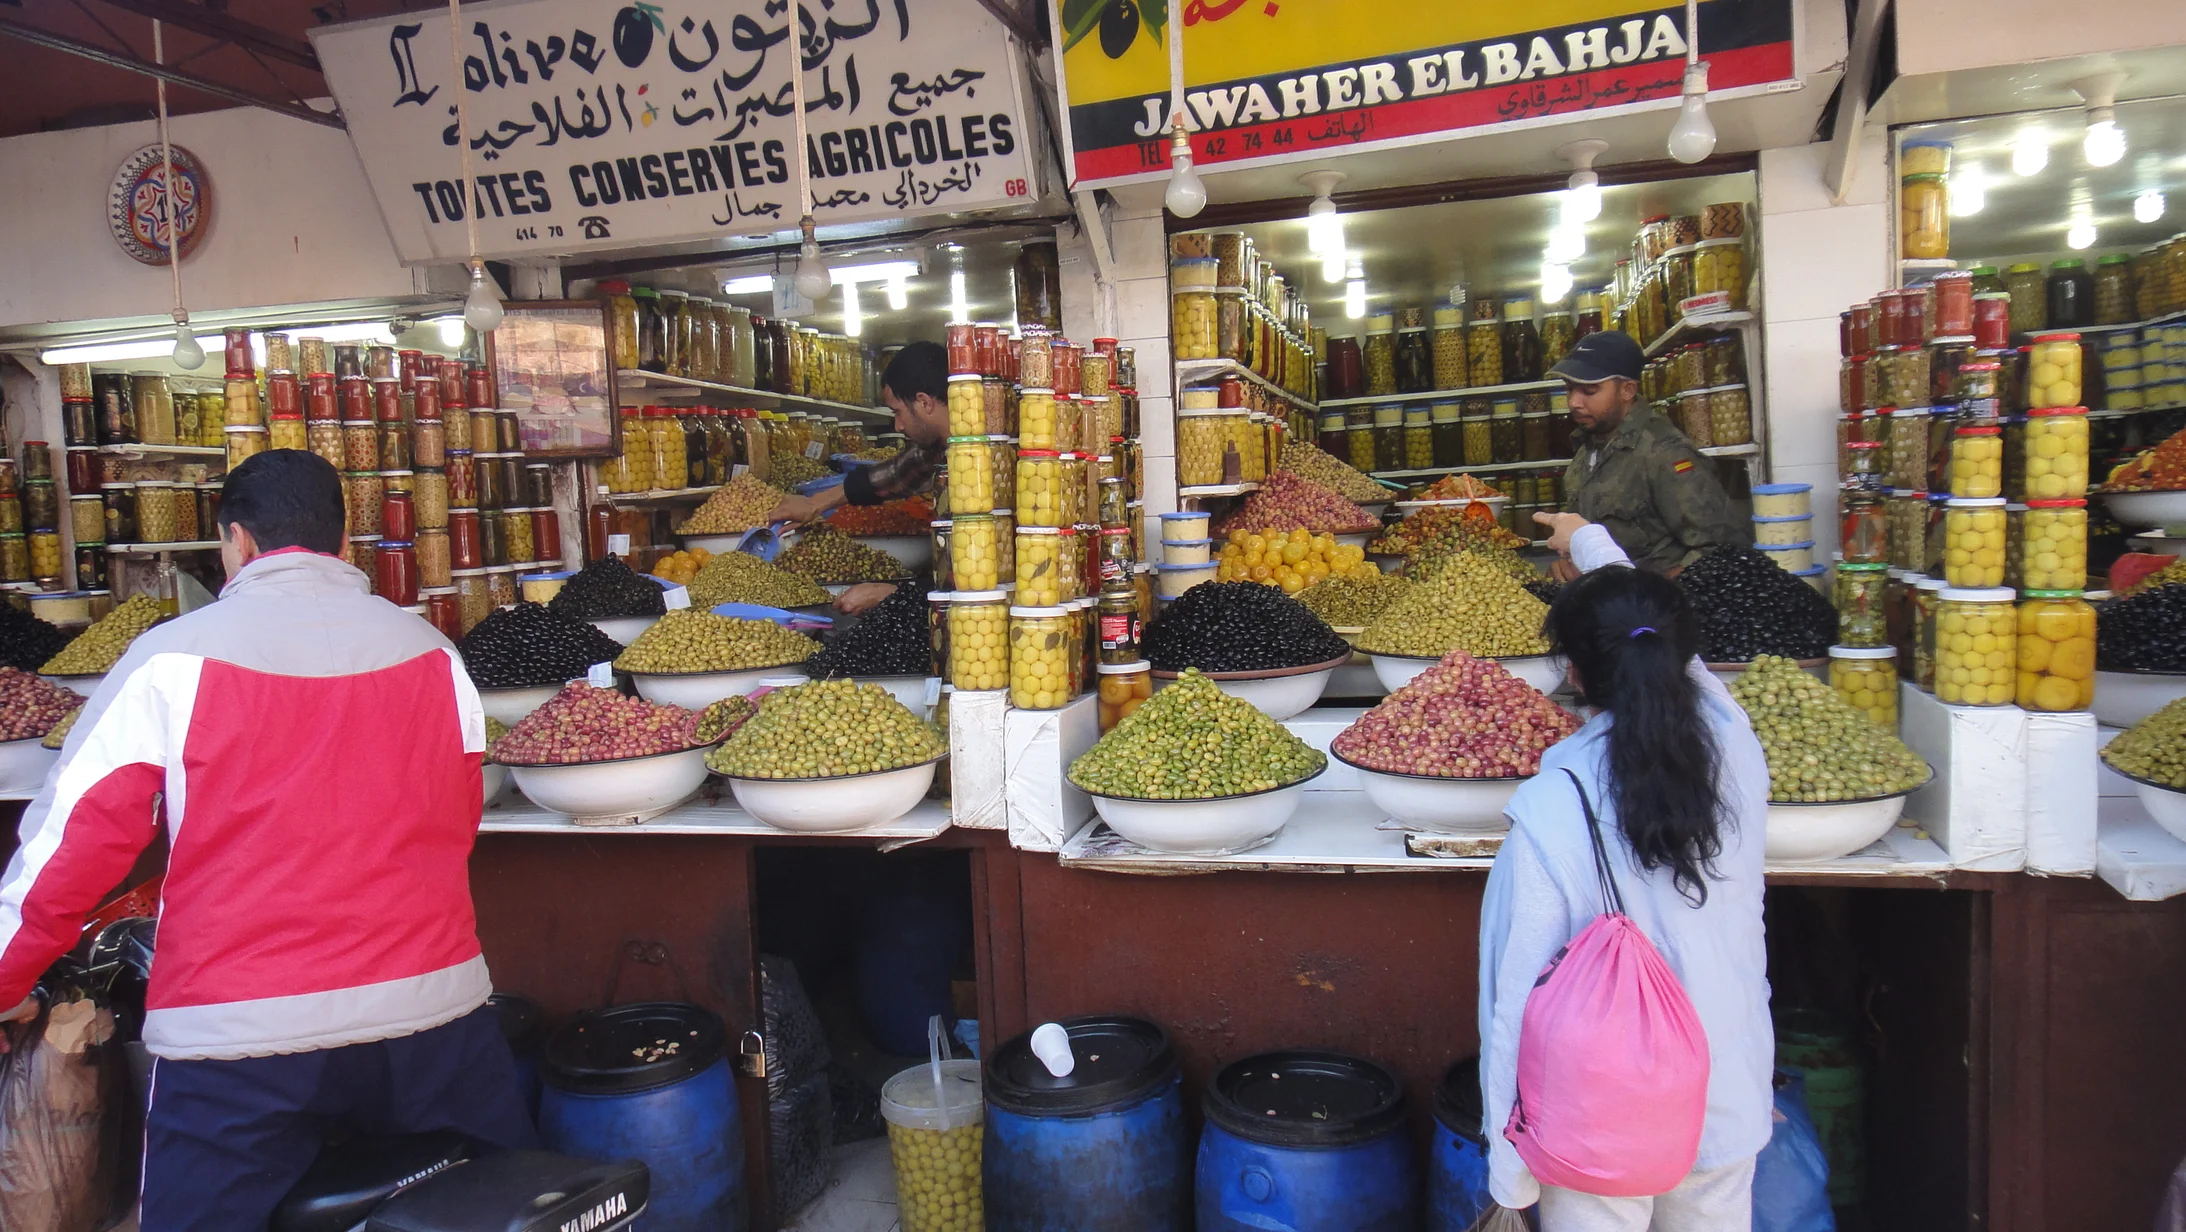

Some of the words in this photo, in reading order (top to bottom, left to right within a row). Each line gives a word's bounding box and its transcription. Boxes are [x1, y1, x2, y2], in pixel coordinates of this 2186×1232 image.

[888, 68, 986, 116] جميع
[1134, 61, 1404, 138] JAWAHER
[1407, 50, 1479, 98] EL
[1480, 14, 1688, 86] BAHJA
[442, 83, 632, 161] الفلاحية
[1307, 111, 1375, 143] الهاتف
[1138, 140, 1165, 167] TEL
[1205, 137, 1226, 157] 42
[1242, 131, 1263, 150] 74
[1272, 128, 1294, 147] 44
[412, 169, 552, 224] TOUTES
[568, 139, 789, 208] CONSERVES
[808, 112, 1016, 180] AGRICOLES
[1004, 178, 1027, 197] GB
[711, 191, 783, 226] جمال
[548, 225, 564, 238] 70
[560, 1192, 628, 1232] YAMAHA
